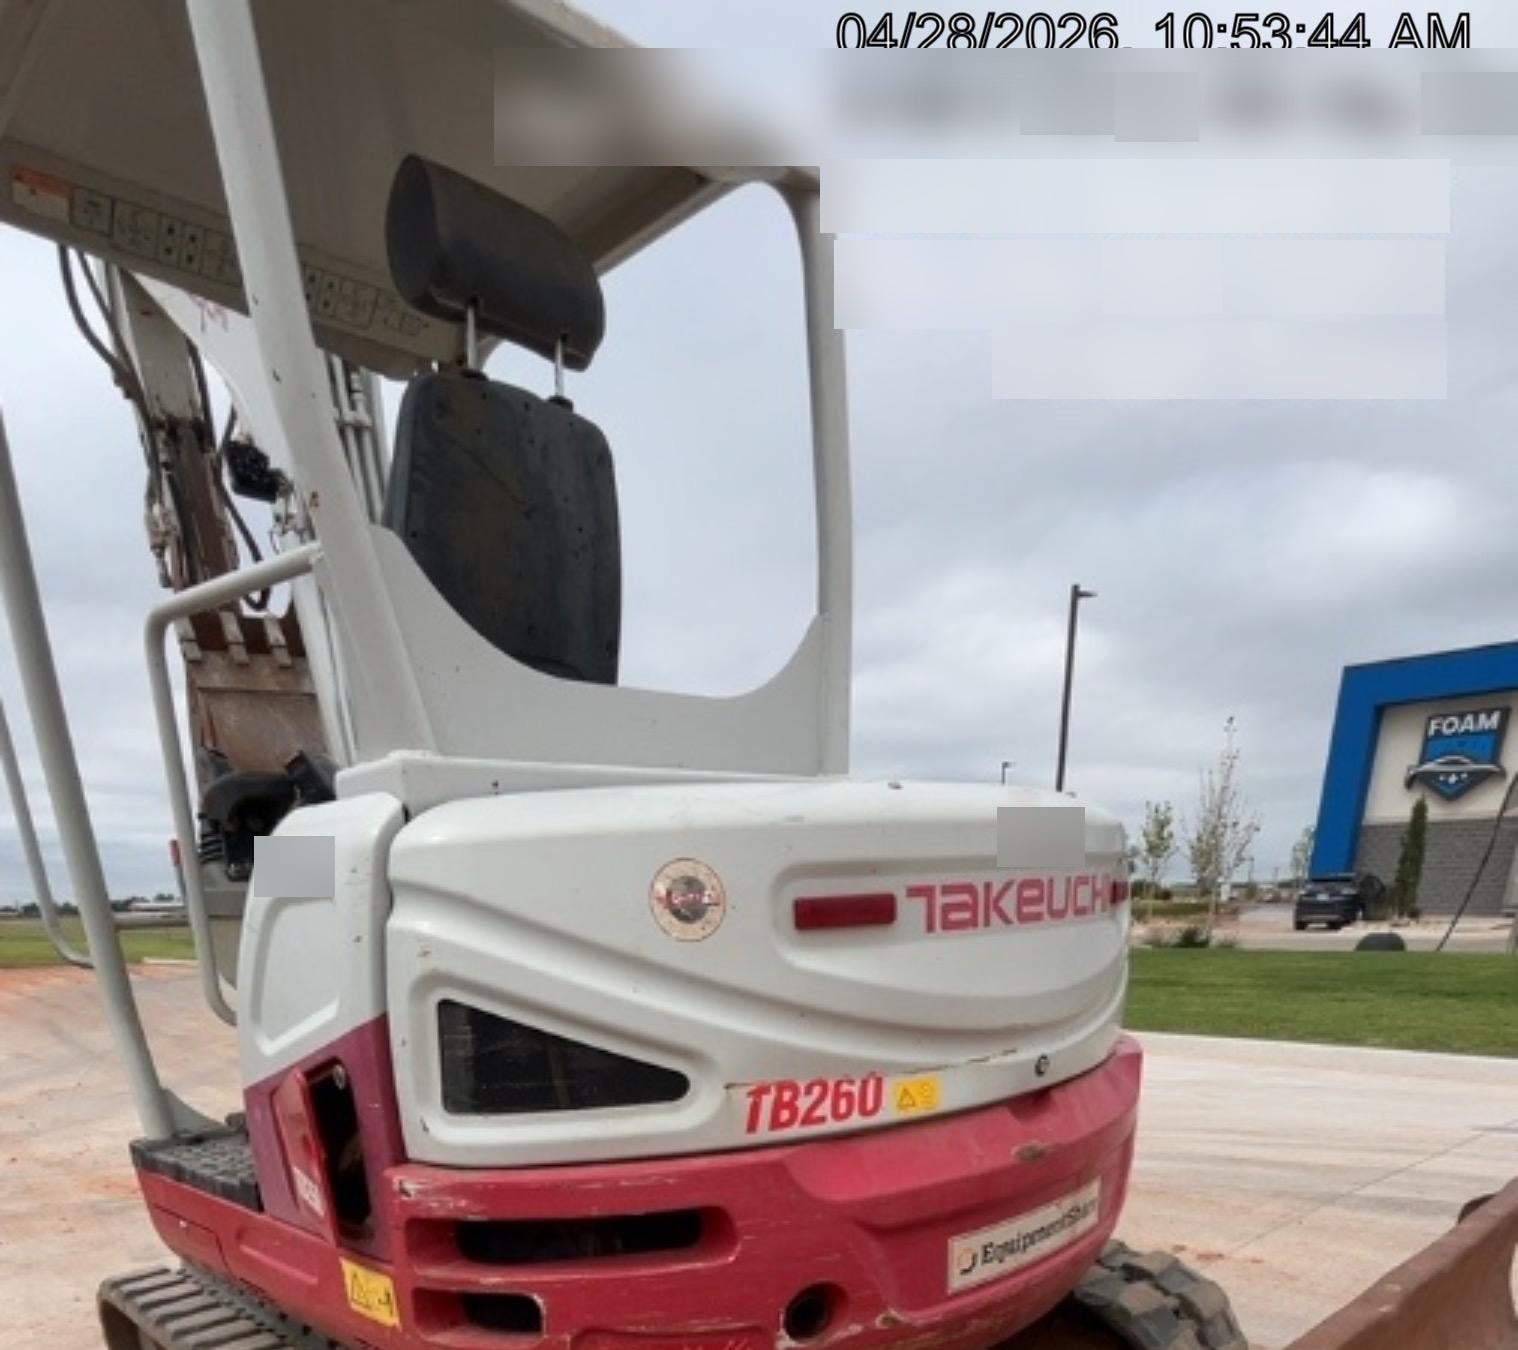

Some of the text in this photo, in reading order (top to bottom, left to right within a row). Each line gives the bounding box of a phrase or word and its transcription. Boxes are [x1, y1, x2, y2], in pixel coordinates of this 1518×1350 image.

[1428, 709, 1501, 738] FOAM
[906, 875, 1112, 933] TAKEUCH
[746, 1075, 883, 1134] TB260
